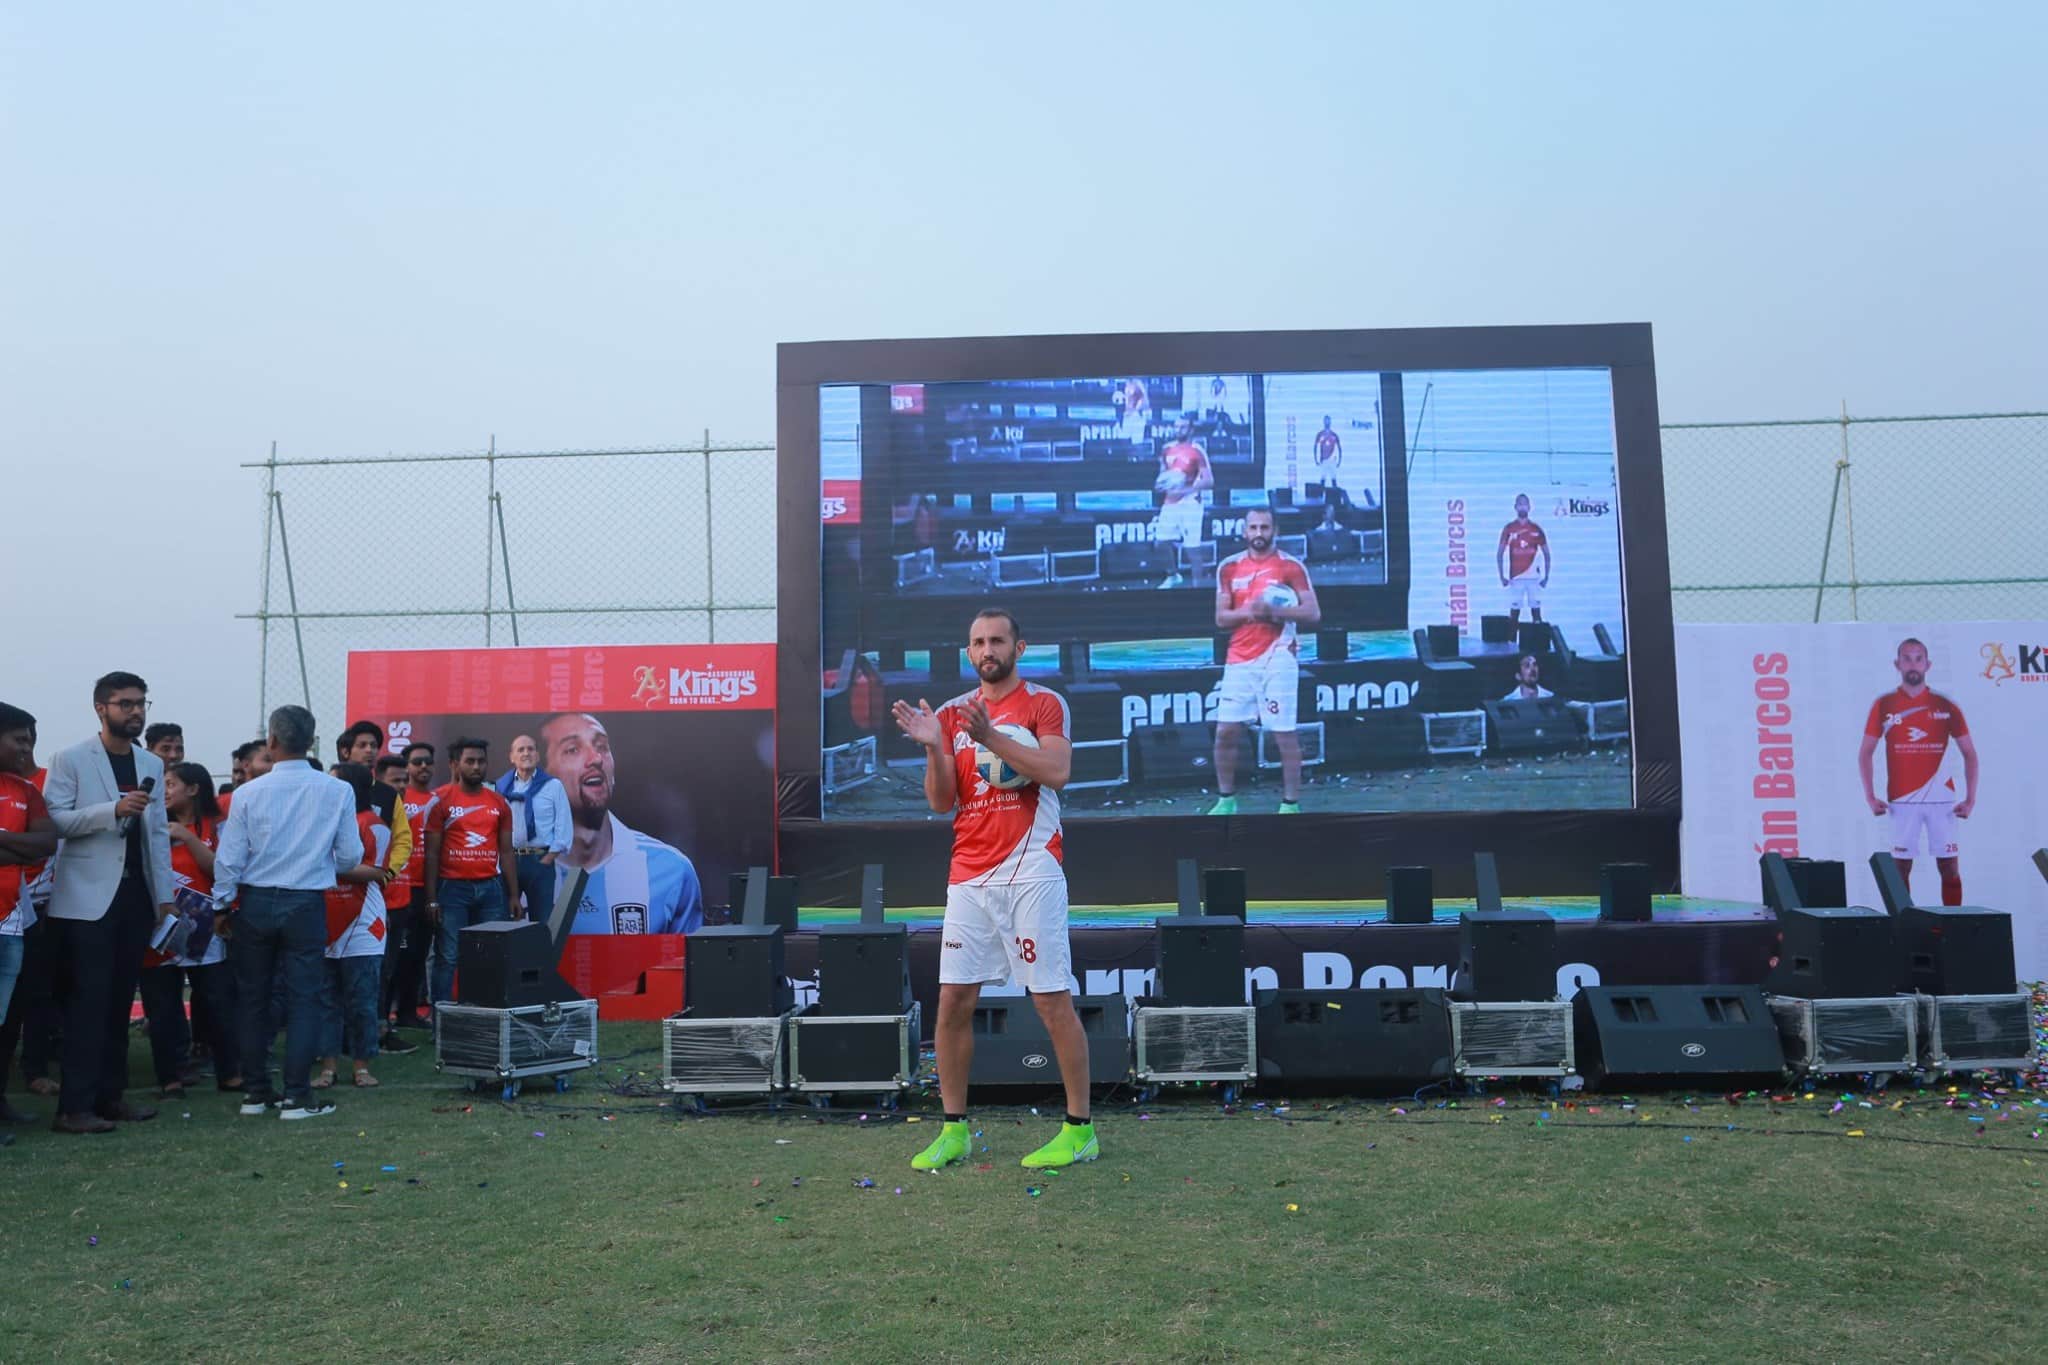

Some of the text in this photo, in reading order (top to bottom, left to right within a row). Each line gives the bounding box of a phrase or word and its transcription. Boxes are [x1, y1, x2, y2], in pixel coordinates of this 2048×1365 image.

[1569, 498, 1610, 517] Kings
[1446, 499, 1467, 577] Barcos
[669, 666, 758, 703] Kings
[1752, 652, 1796, 798] Barcos
[1886, 713, 1902, 725] 28
[449, 805, 465, 818] 28
